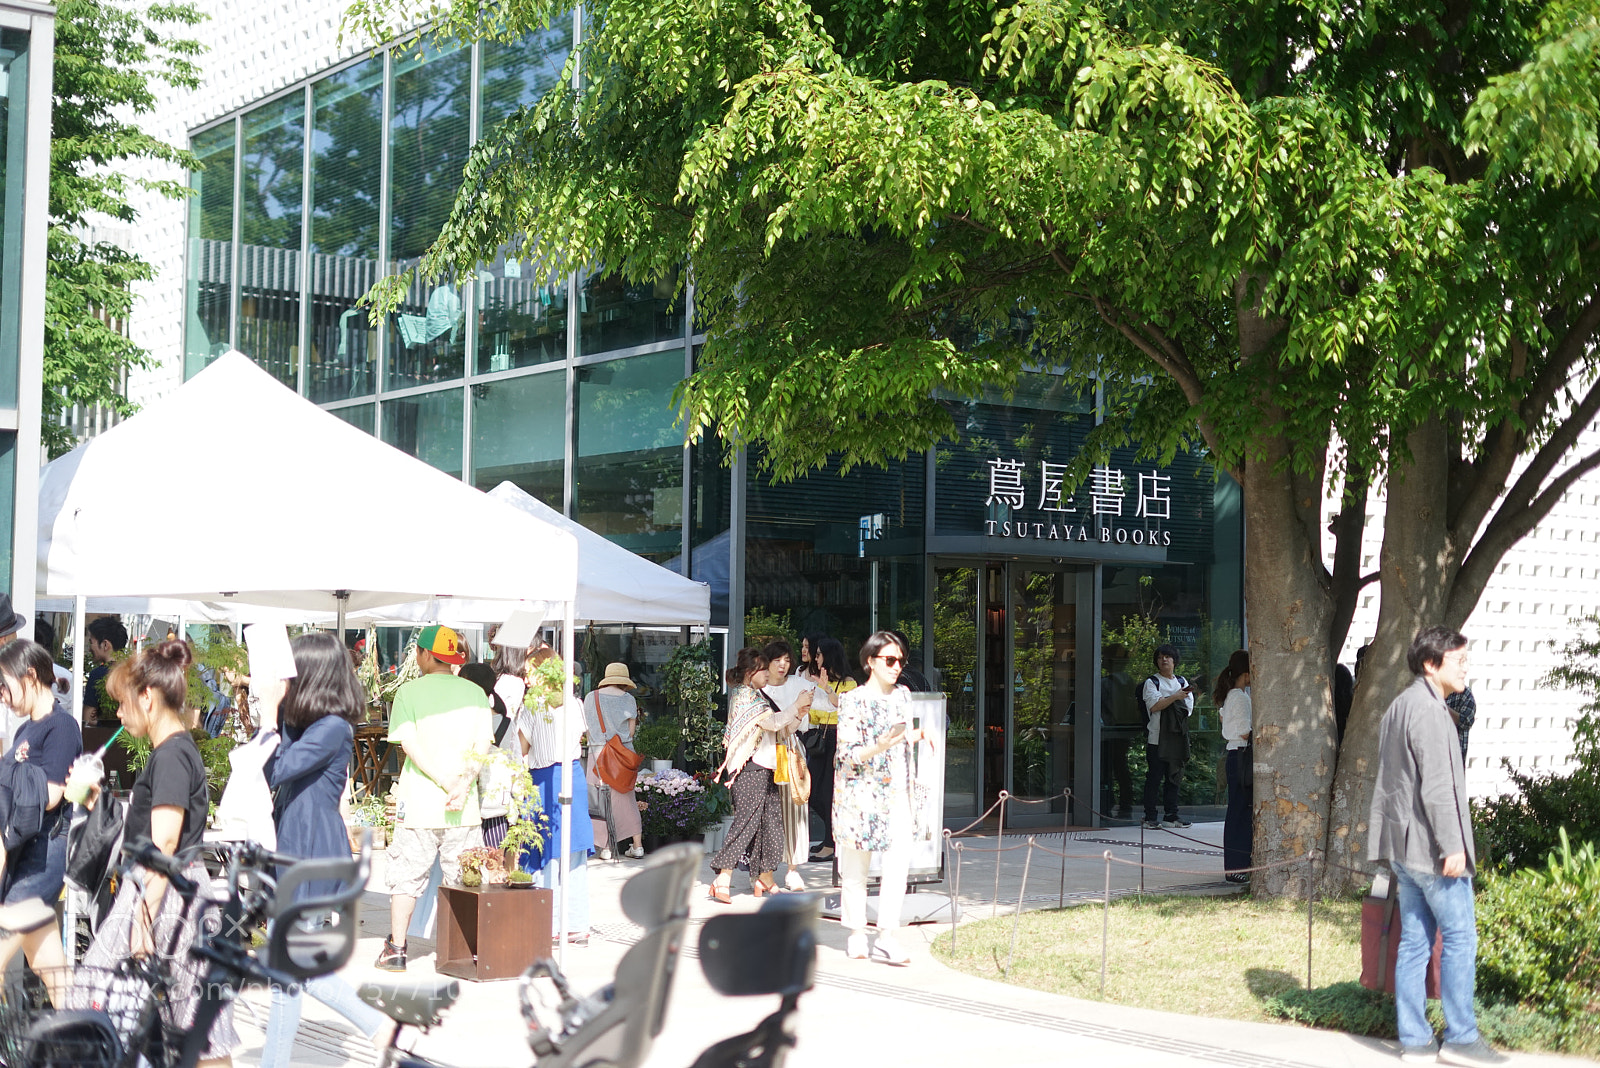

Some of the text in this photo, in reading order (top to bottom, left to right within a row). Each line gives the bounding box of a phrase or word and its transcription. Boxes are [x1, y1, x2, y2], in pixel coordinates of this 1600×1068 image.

[985, 457, 1171, 519] 蔦屋書店
[985, 519, 1171, 546] TSUTAYA BOOKS
